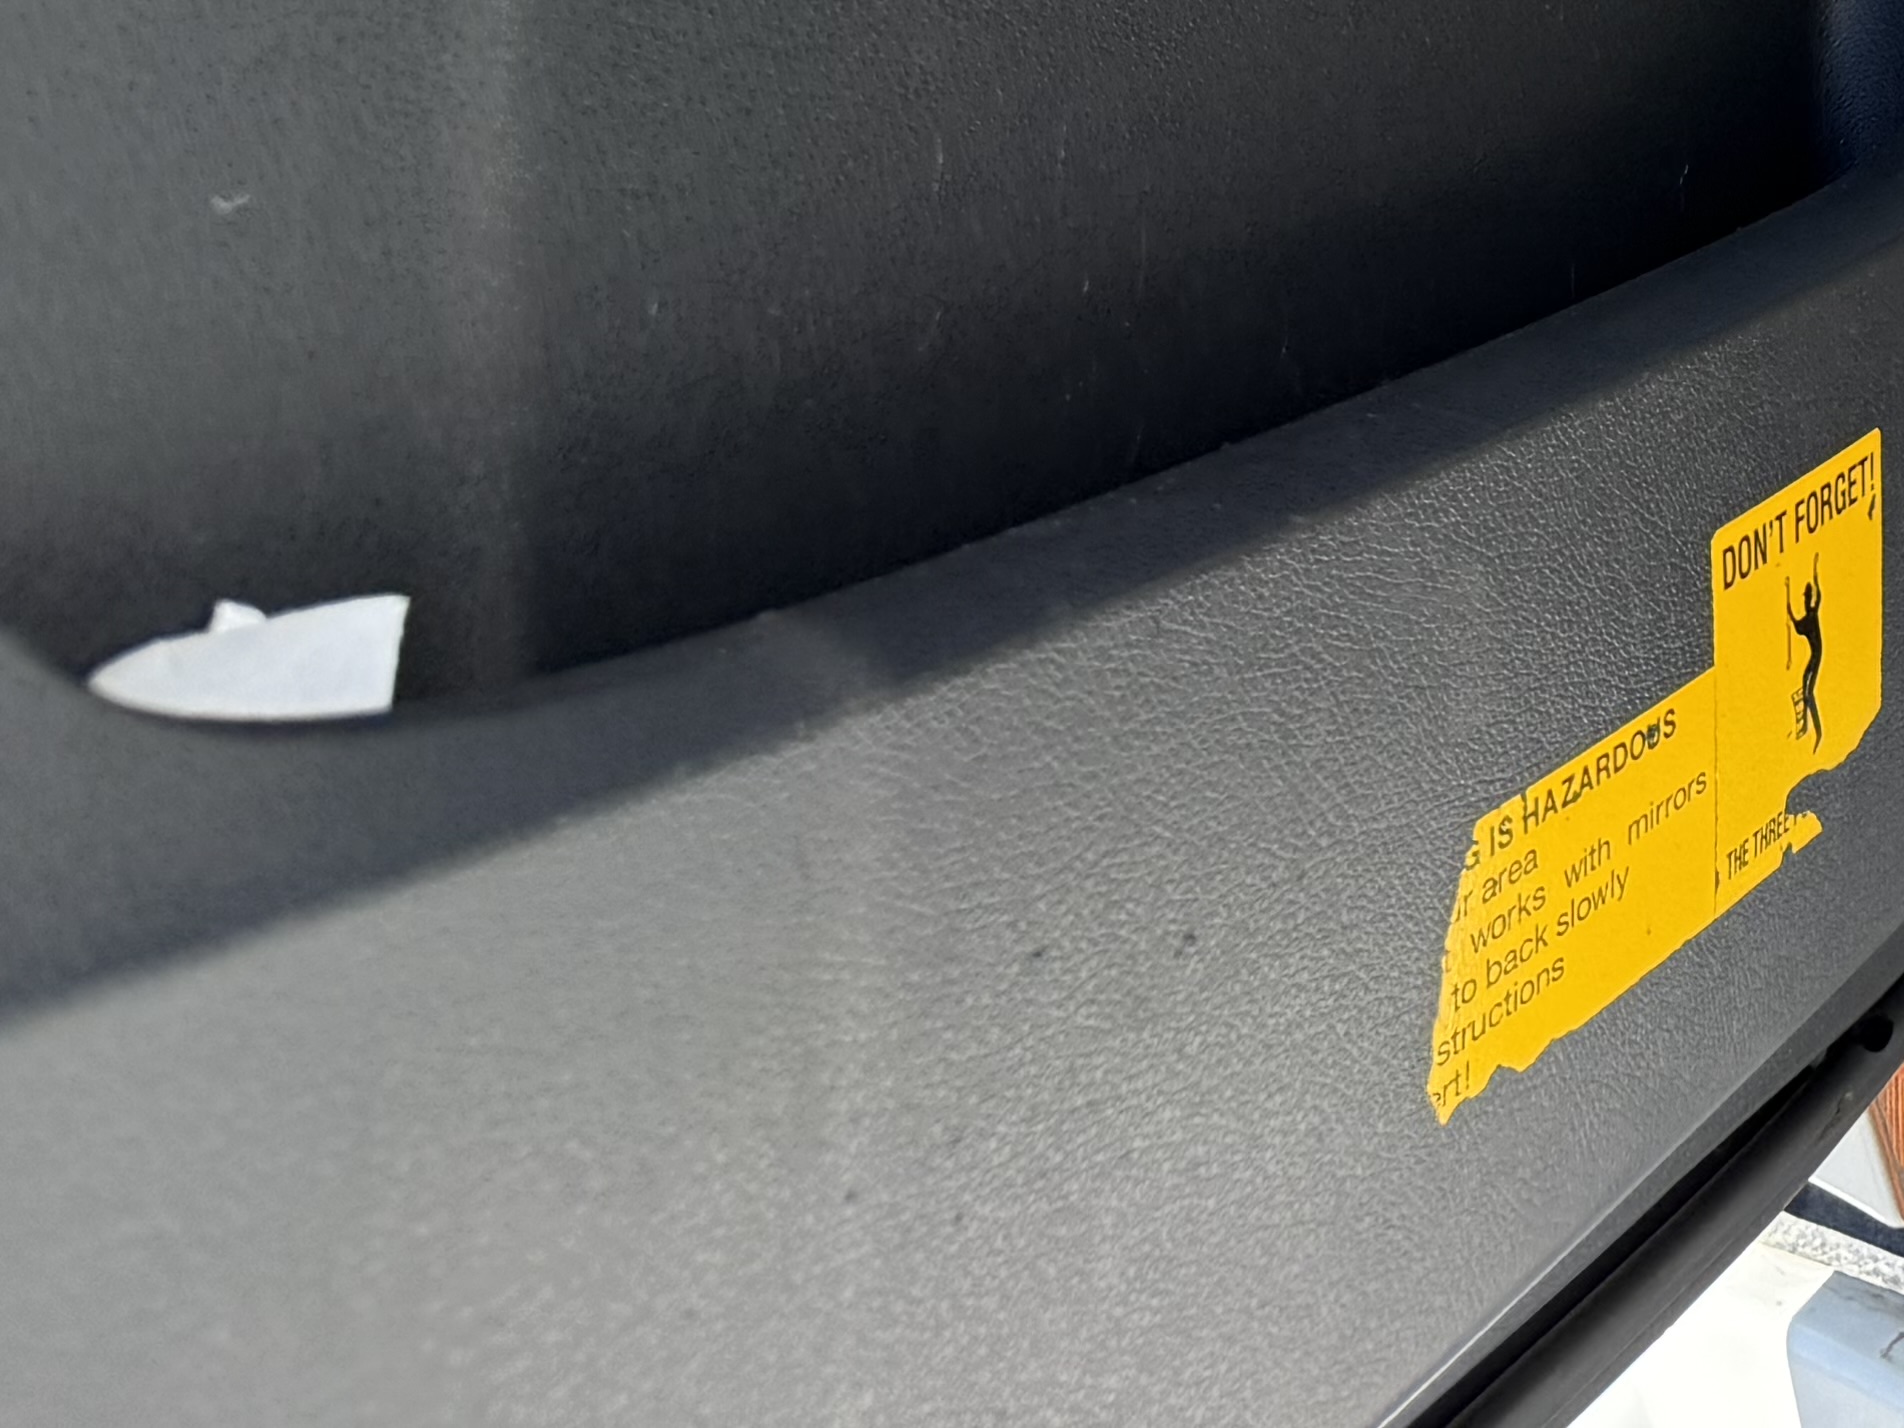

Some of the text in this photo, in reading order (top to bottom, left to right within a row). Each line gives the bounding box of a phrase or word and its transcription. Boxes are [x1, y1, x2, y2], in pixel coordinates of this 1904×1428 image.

[1723, 452, 1875, 591] DON'T FORGET!
[1490, 708, 1677, 857] IS HAZARDOUS
[1726, 811, 1790, 880] THE THREE
[1470, 771, 1708, 953] works with mirrors
[1482, 848, 1539, 904] area
[1451, 866, 1629, 1013] to back slowly
[1436, 956, 1565, 1066] structions
